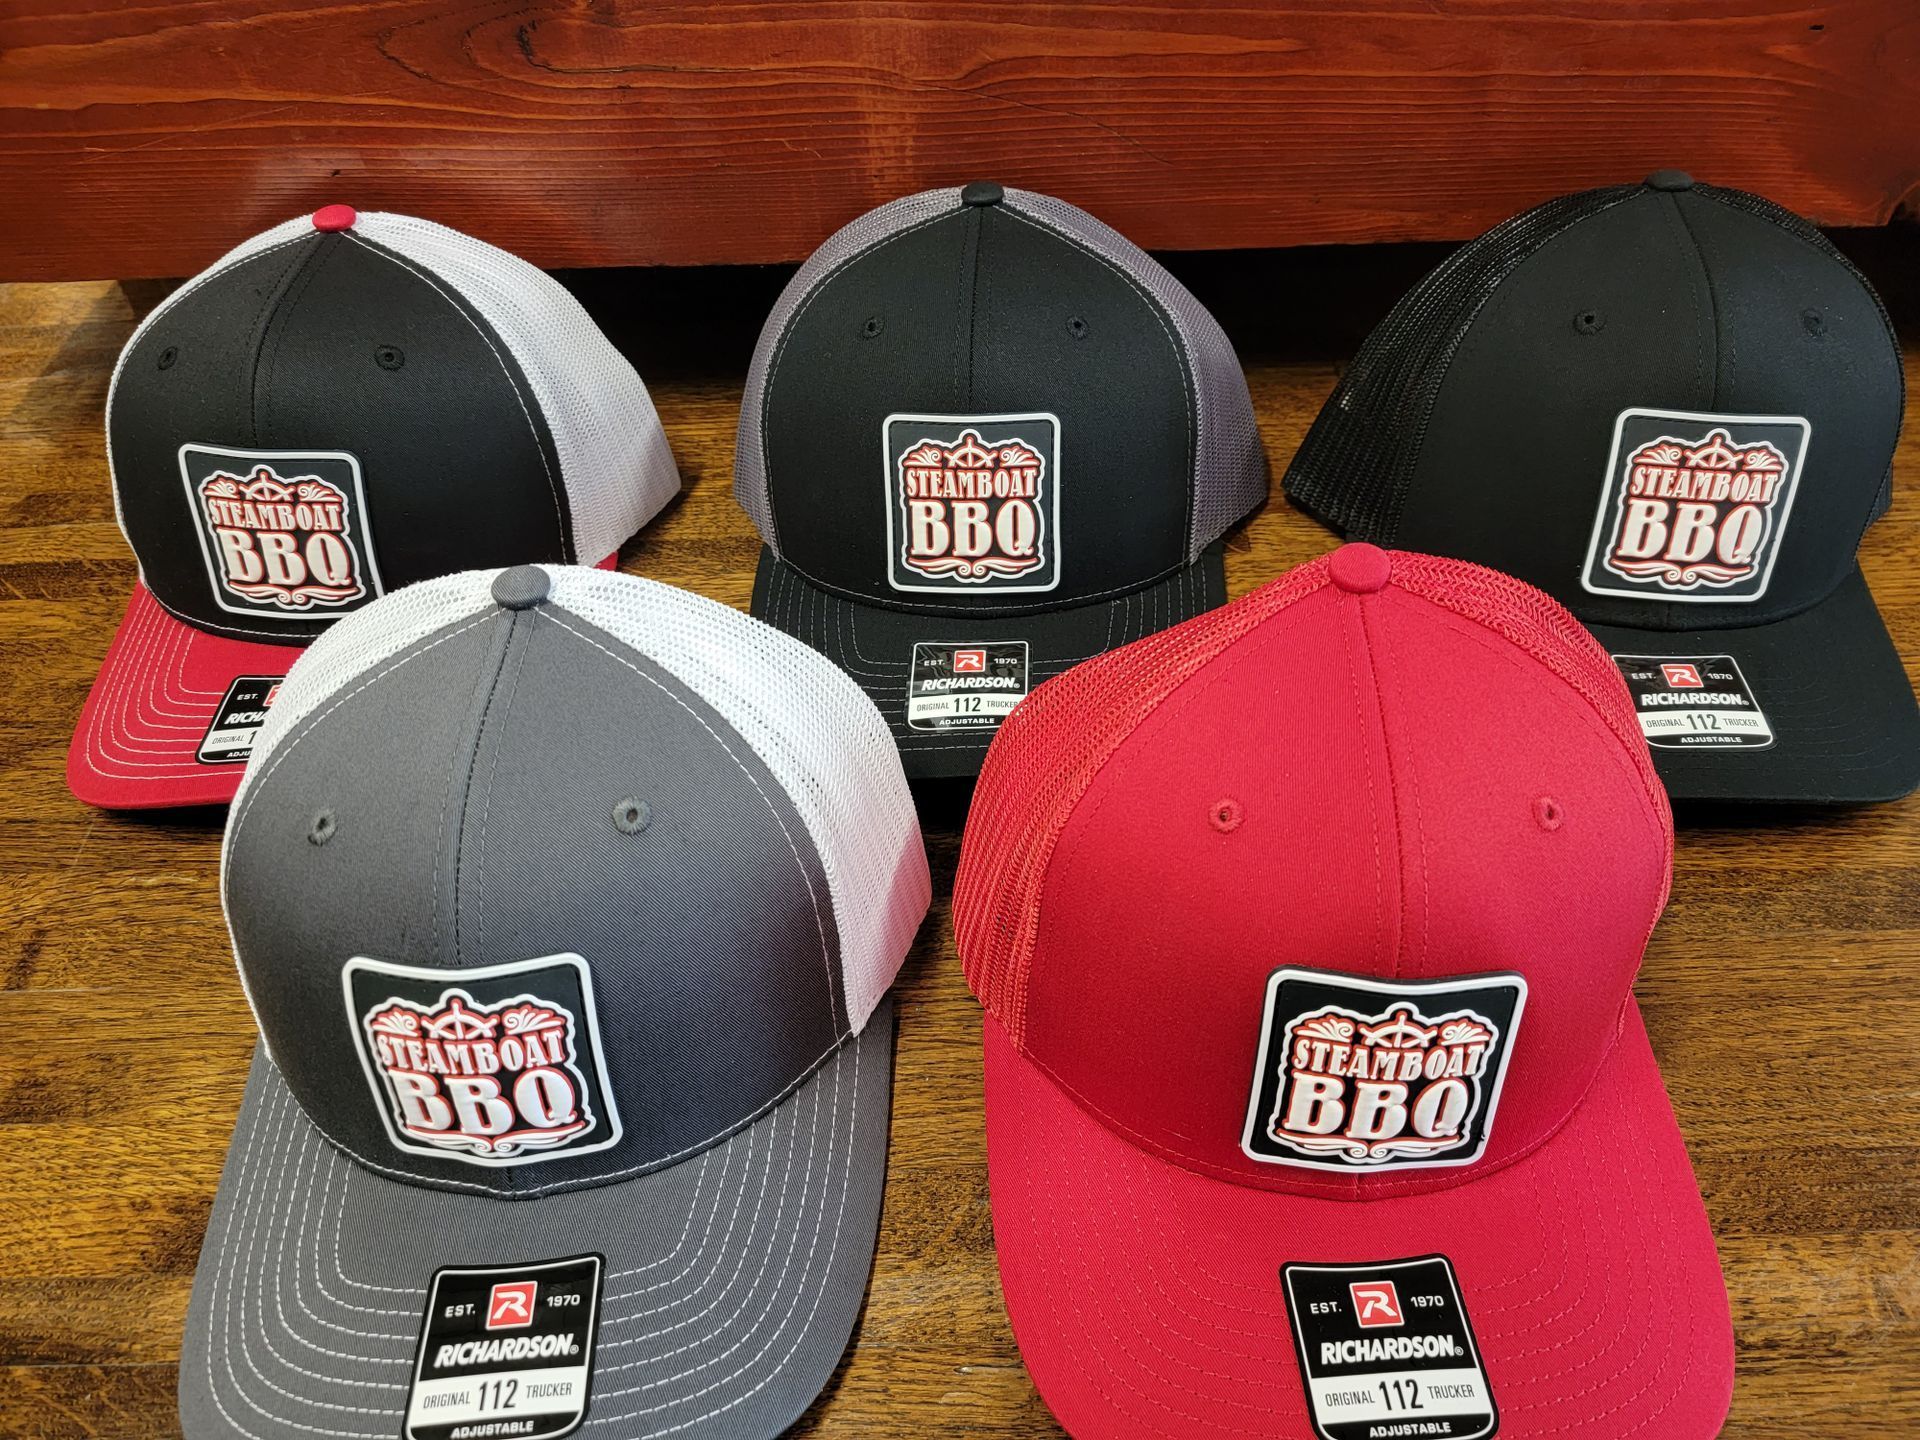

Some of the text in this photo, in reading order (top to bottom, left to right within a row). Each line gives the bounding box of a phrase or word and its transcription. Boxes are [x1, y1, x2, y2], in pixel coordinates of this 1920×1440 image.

[906, 468, 1037, 498] STEAMBOAT
[1630, 465, 1778, 502] STEAMBOAT
[208, 499, 342, 531] STEAMBOAT
[908, 498, 1036, 557] BBQ
[1616, 497, 1763, 565] BBQ
[216, 526, 352, 586] BBQ
[1631, 672, 1656, 680] EST.
[917, 702, 949, 711] ORIGINAL
[954, 697, 981, 713] 112
[1645, 714, 1759, 730] ORIGINAL 112 TRUCKER
[212, 735, 244, 744] ORIGINAL
[376, 1029, 566, 1075] STEAMBOAT
[1292, 1039, 1486, 1081] STEAMBOAT
[388, 1066, 578, 1135] BBQ
[1284, 1069, 1470, 1140] BBQ
[444, 1294, 580, 1318] EST. 1970
[1310, 1295, 1445, 1314] EST. 1970
[423, 1378, 573, 1411] ORIGINAL 112 TRUCKER
[1325, 1378, 1475, 1411] ORIGINAL 112 TRUCKER
[451, 1421, 534, 1439] ADJUSTABLE
[1369, 1422, 1451, 1438] ADJUSTABLE
